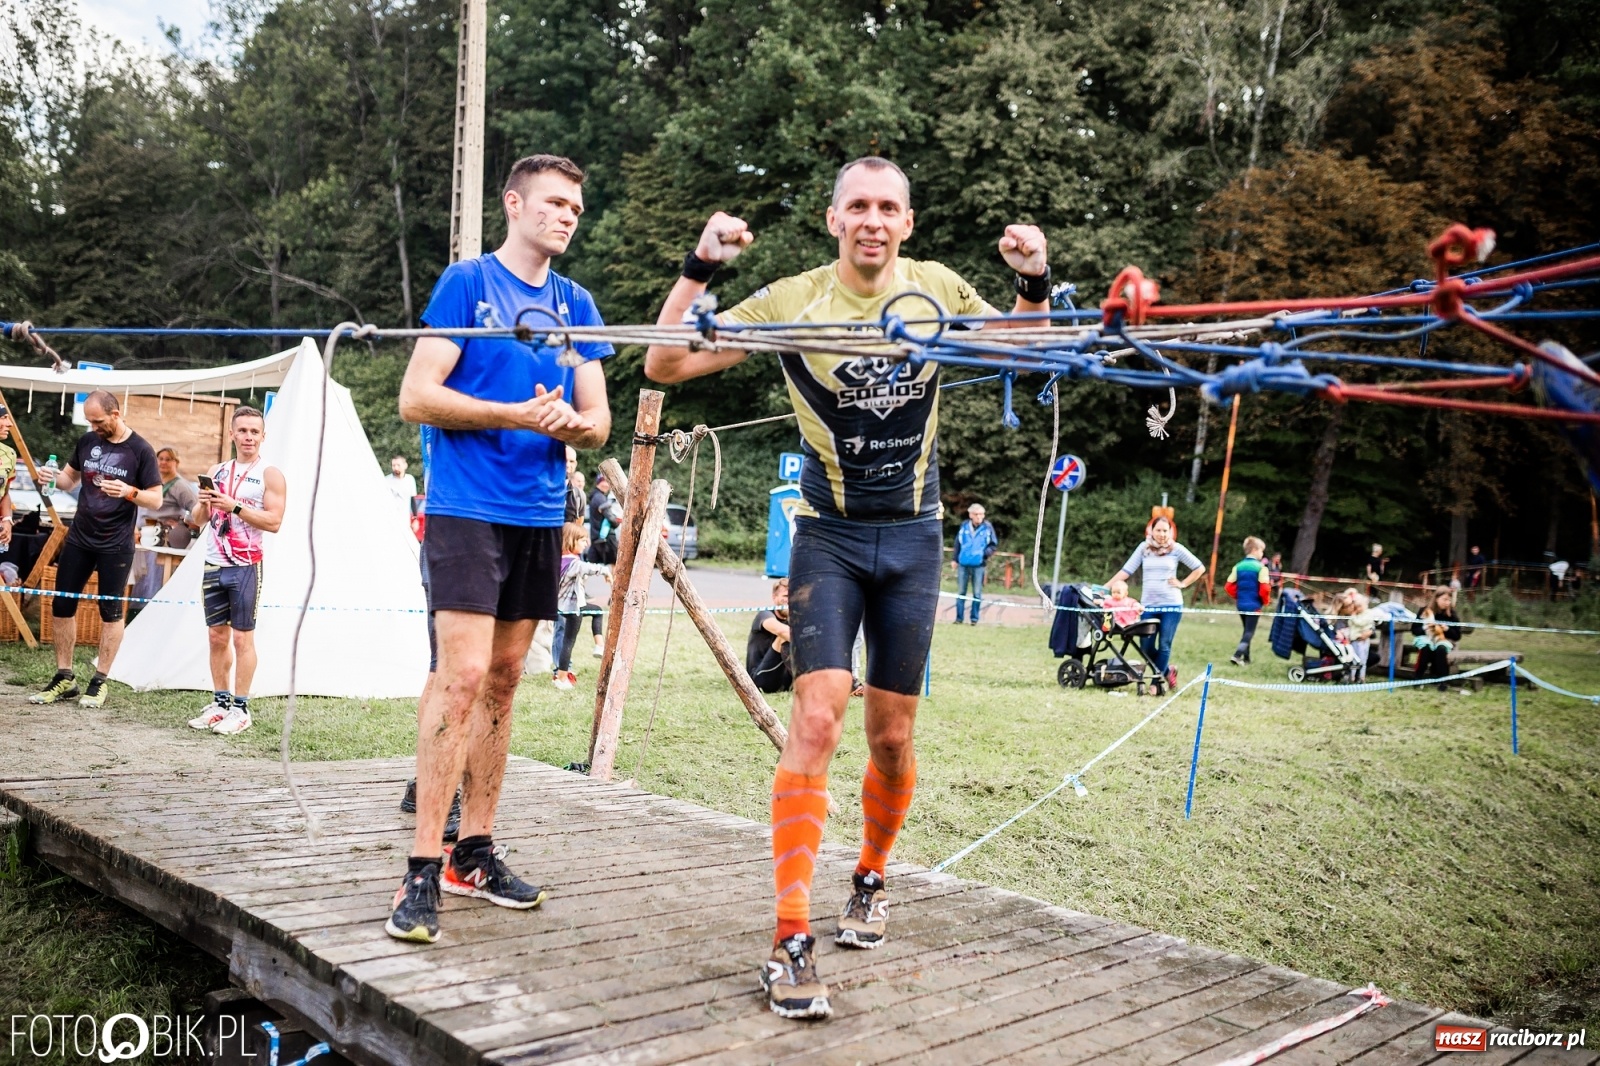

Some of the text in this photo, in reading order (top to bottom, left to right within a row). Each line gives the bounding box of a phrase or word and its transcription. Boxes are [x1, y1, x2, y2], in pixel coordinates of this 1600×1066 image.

[838, 381, 926, 405] SOCIOS
[863, 399, 901, 408] SILESIA
[869, 433, 922, 450] ReShape
[784, 456, 800, 477] P
